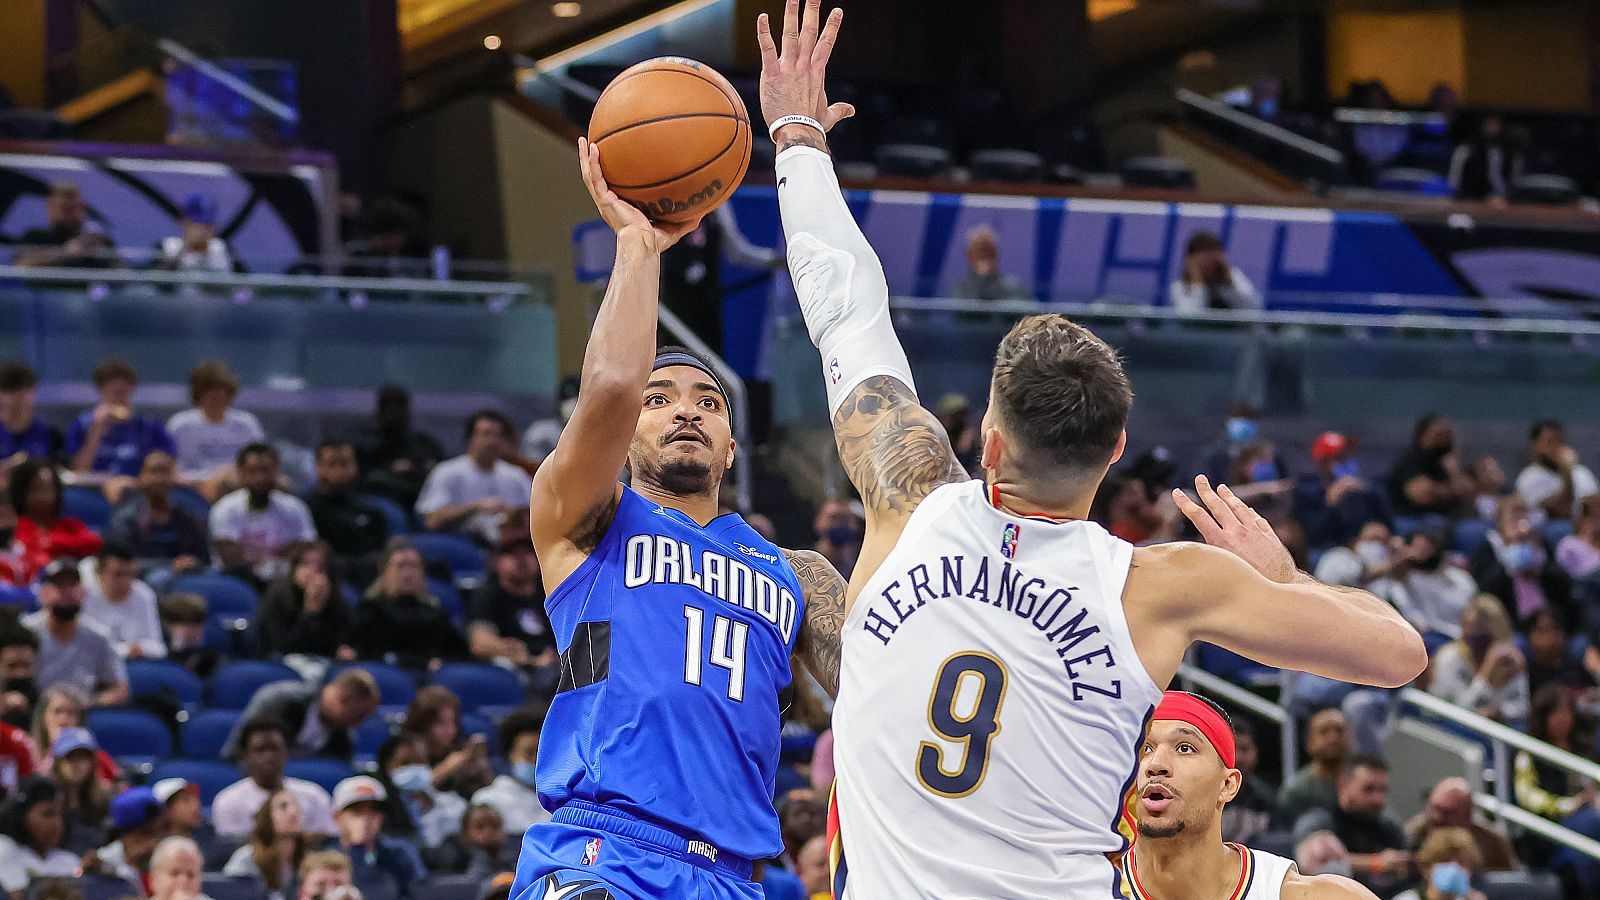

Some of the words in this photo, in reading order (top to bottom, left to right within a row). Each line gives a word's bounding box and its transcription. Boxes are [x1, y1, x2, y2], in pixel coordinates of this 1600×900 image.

[624, 534, 797, 646] ORLANDO
[863, 556, 1122, 701] HERNANGÓMEZ
[683, 604, 750, 703] 14
[915, 650, 1009, 799] 9
[687, 840, 718, 863] MAGIC
